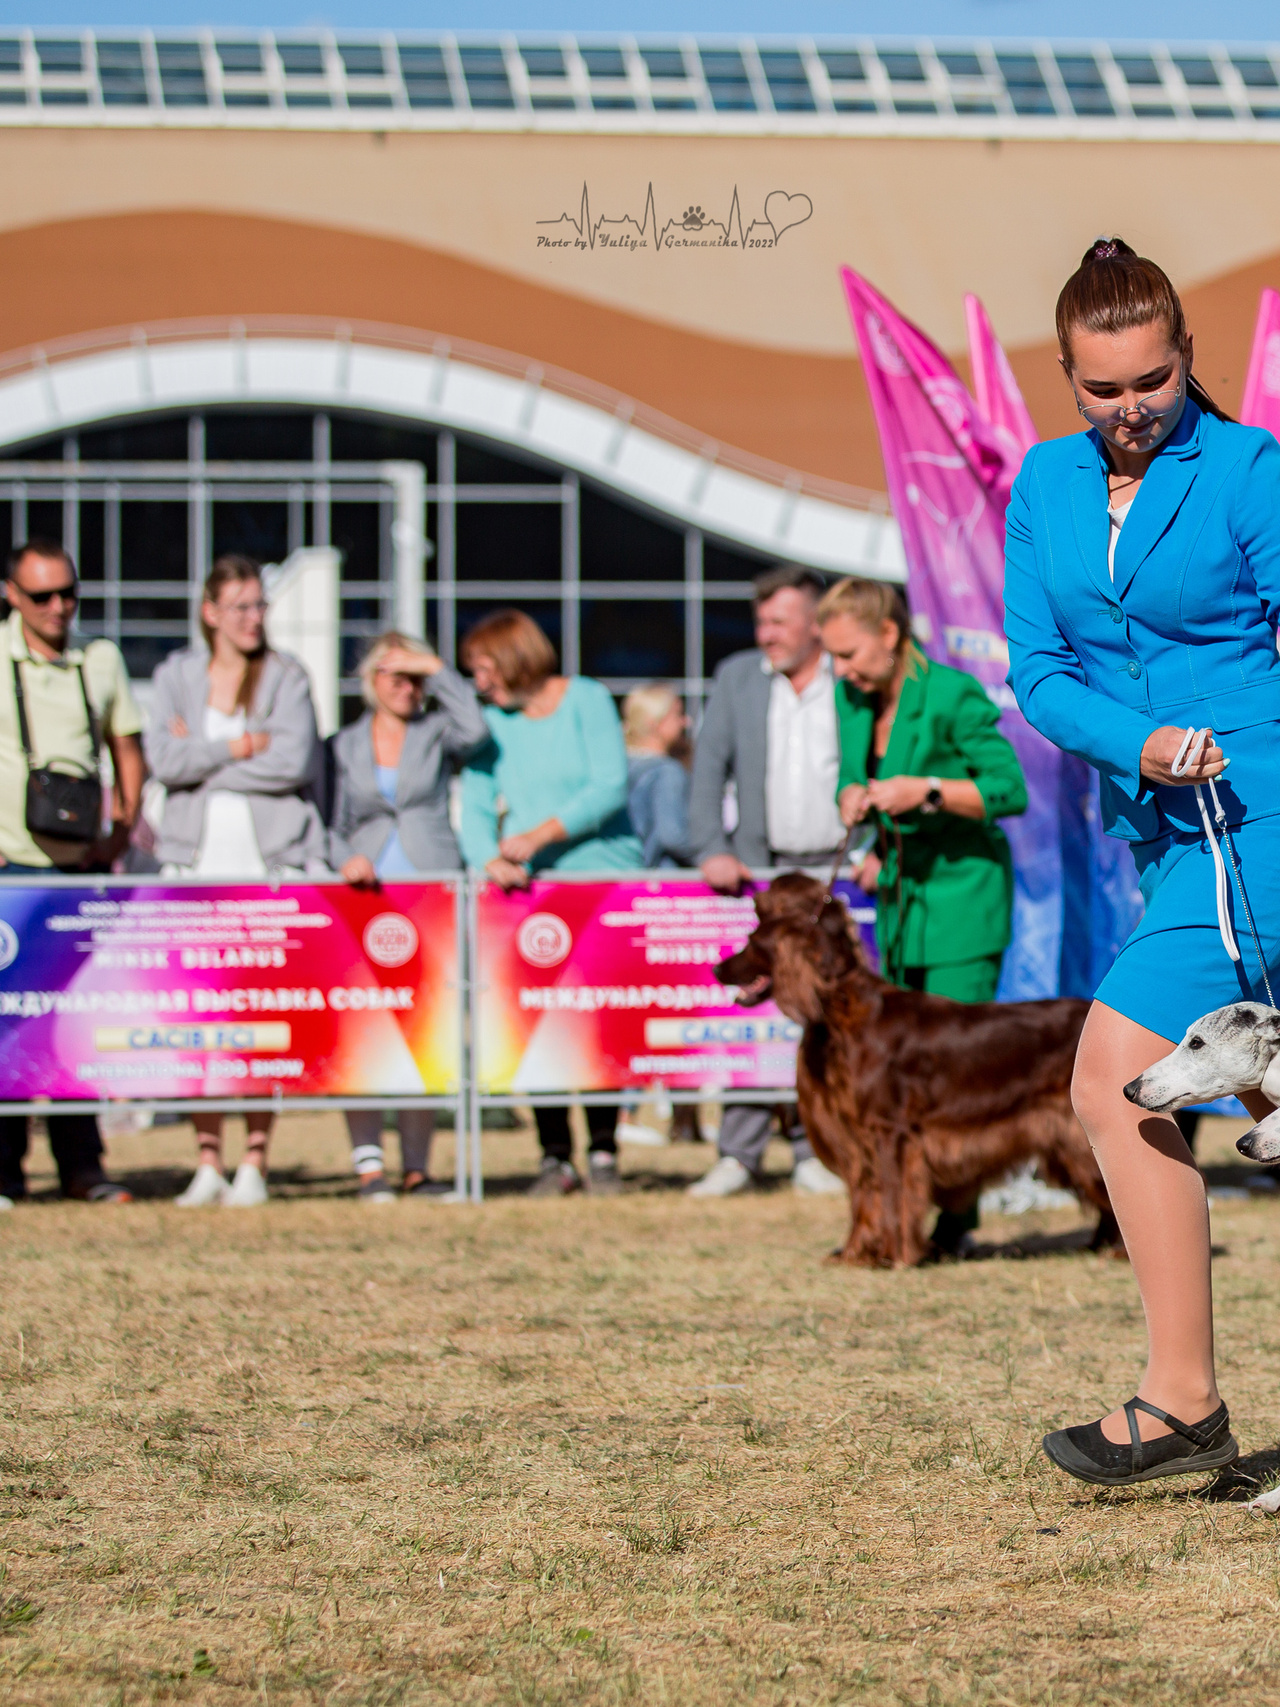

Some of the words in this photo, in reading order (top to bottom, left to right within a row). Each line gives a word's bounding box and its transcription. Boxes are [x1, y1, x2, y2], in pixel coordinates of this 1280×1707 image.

[180, 946, 287, 969] BELARUS
[192, 988, 325, 1012] ВЫСТАВКА
[328, 986, 414, 1010] СОБАК
[128, 1027, 206, 1050] CACIB
[681, 1022, 757, 1044] CACIB
